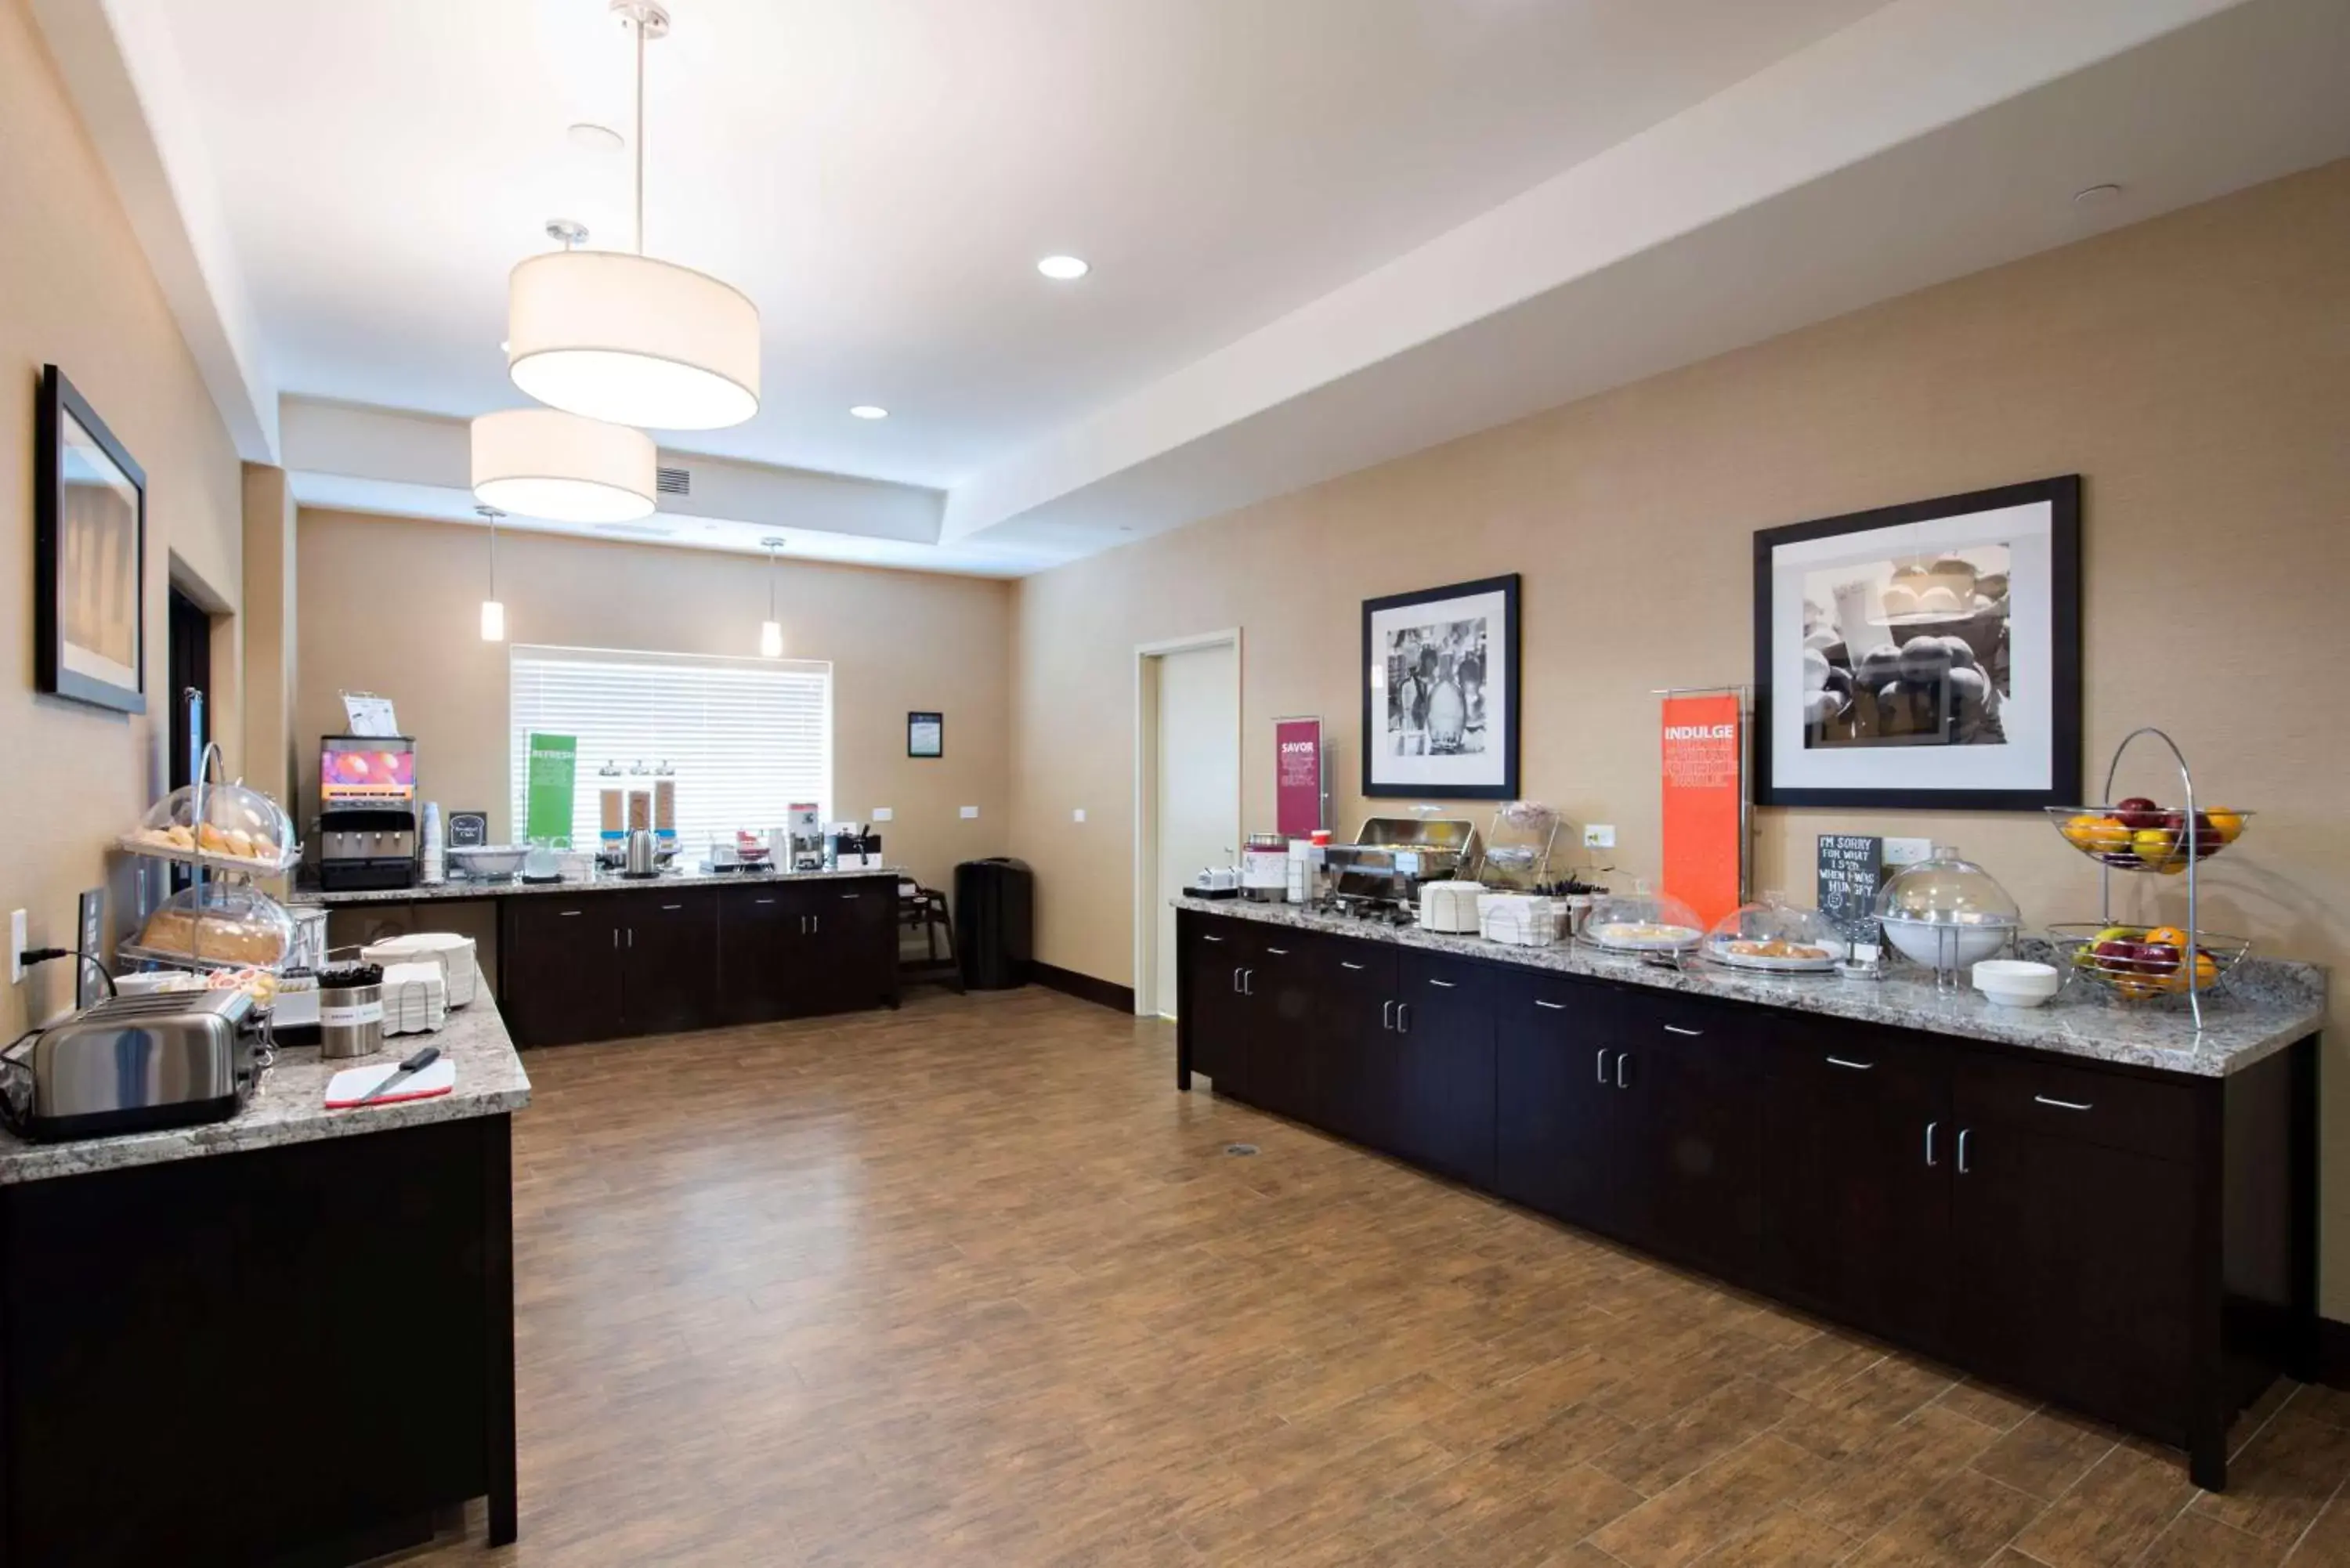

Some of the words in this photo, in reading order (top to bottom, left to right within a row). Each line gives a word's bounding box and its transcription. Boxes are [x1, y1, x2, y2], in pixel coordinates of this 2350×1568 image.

[1665, 724, 1734, 739] INDULGE
[1281, 742, 1314, 753] SAVOR
[1836, 837, 1872, 851] SORRY
[1823, 848, 1840, 859] FOR
[1843, 850, 1870, 861] WHAT
[1819, 869, 1845, 880] WHEN
